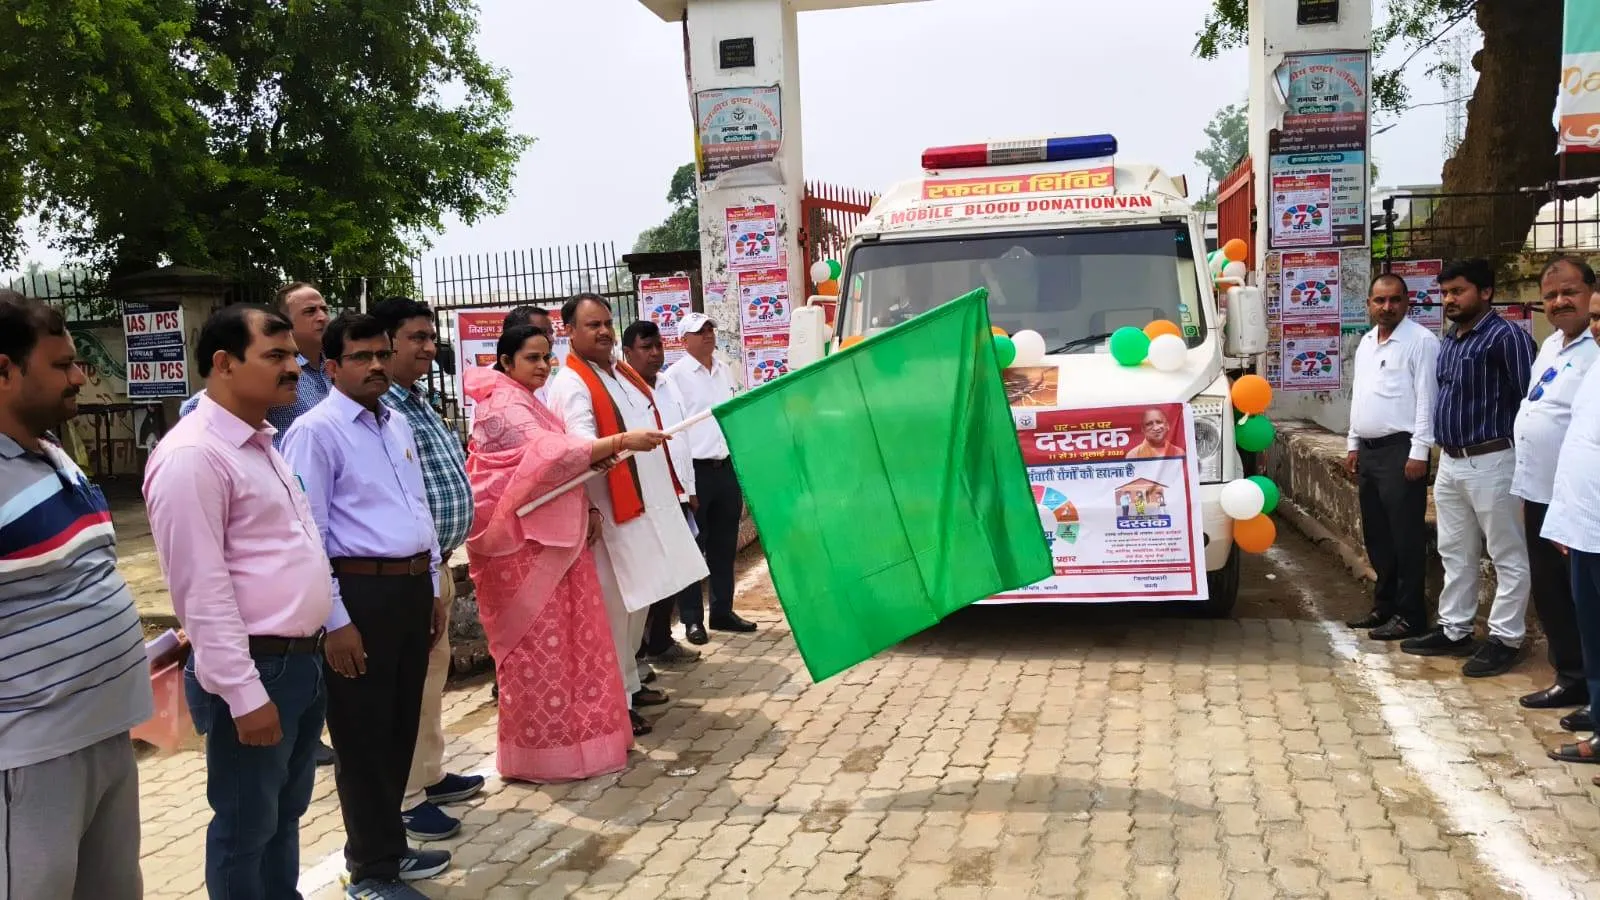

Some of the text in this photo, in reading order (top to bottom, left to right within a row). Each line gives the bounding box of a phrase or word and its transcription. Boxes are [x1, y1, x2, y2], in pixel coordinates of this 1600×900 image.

[926, 171, 1112, 199] रक्तदान शिविर
[889, 206, 953, 226] MOBILE
[964, 201, 1021, 217] BLOOD
[1295, 214, 1307, 225] 7
[746, 241, 757, 252] 7
[1304, 290, 1316, 302] 7
[759, 305, 770, 316] 7
[126, 315, 146, 333] IAS
[155, 312, 178, 330] PCS
[662, 312, 672, 323] 7
[130, 363, 150, 380] IAS
[160, 362, 183, 380] PCS
[1304, 361, 1316, 373] 7
[765, 369, 775, 379] 7
[1055, 424, 1068, 432] घर
[1034, 428, 1132, 452] दस्तक
[1080, 449, 1105, 461] जुलाई
[1080, 465, 1094, 480] को
[1126, 463, 1136, 478] है
[1119, 518, 1170, 528] दस्तक
